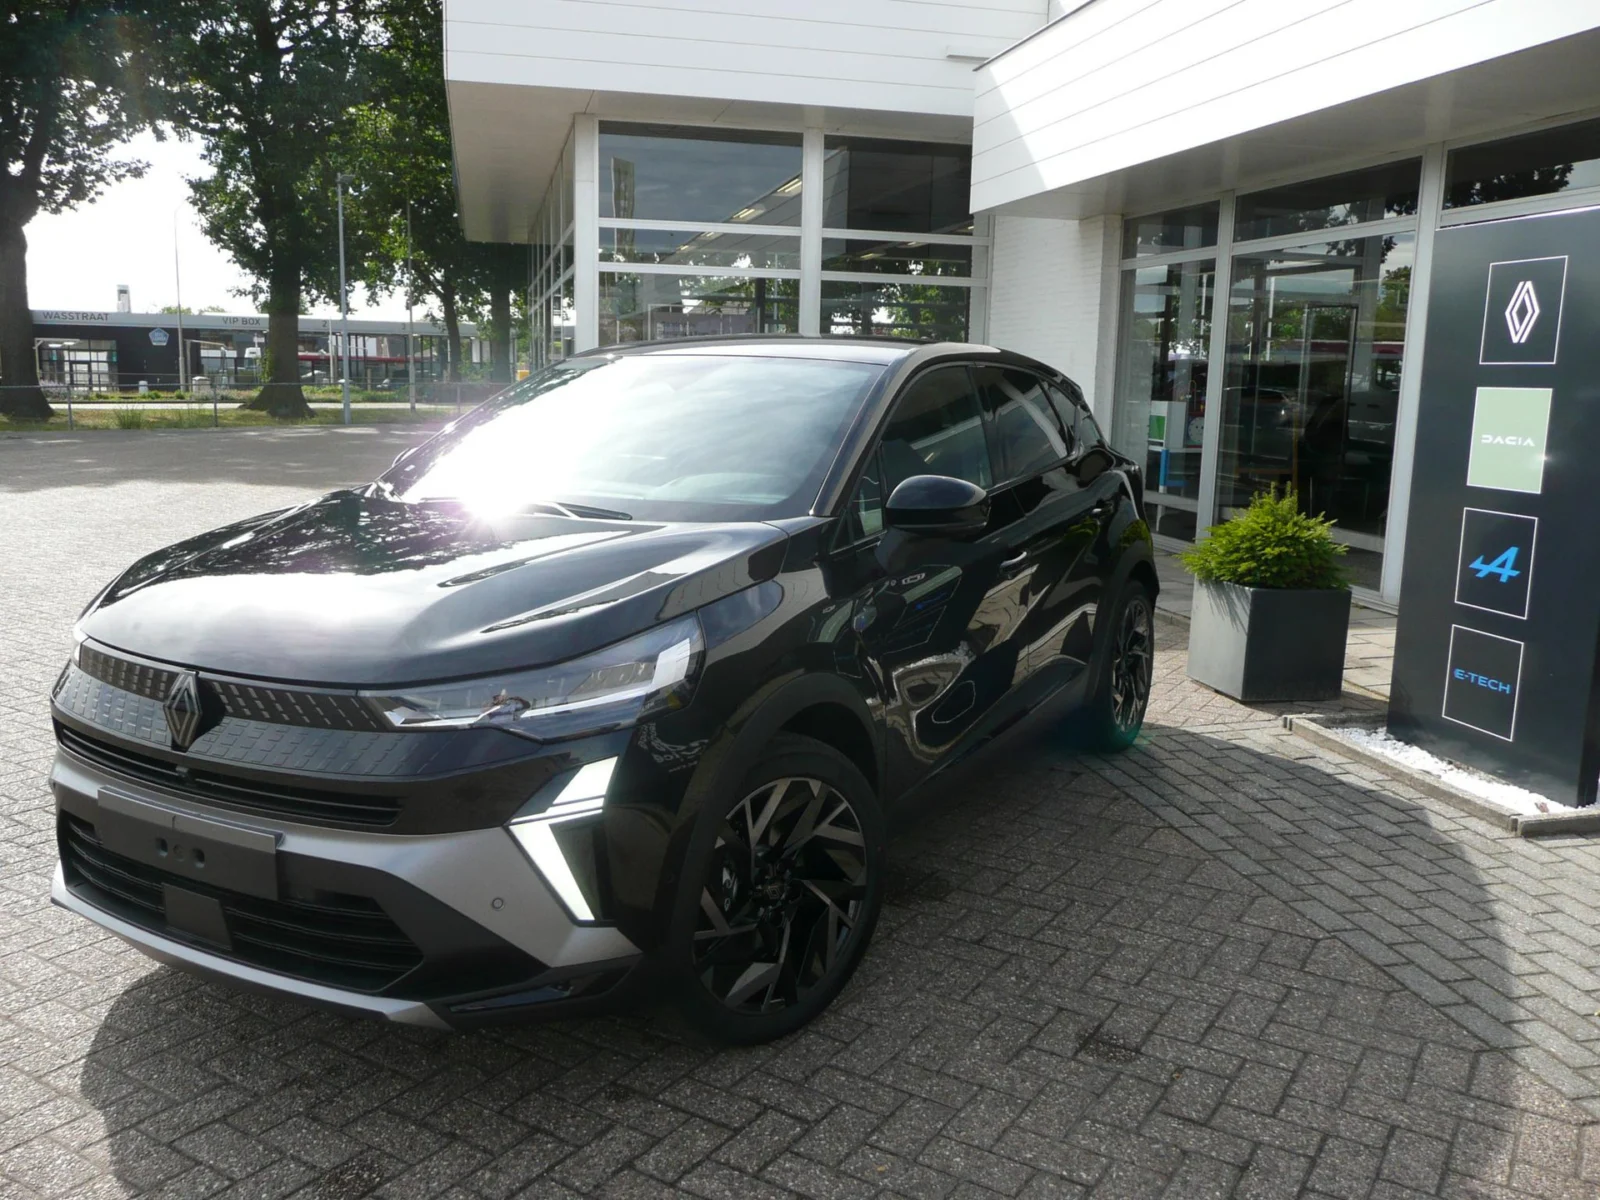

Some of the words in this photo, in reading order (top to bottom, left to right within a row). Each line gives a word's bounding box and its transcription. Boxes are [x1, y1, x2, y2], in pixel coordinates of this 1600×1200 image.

[43, 311, 109, 321] WASSTRAAT
[222, 316, 239, 325] VIP
[241, 317, 261, 326] BOX
[1480, 434, 1536, 447] DACIA
[1453, 668, 1512, 694] E-TECH
